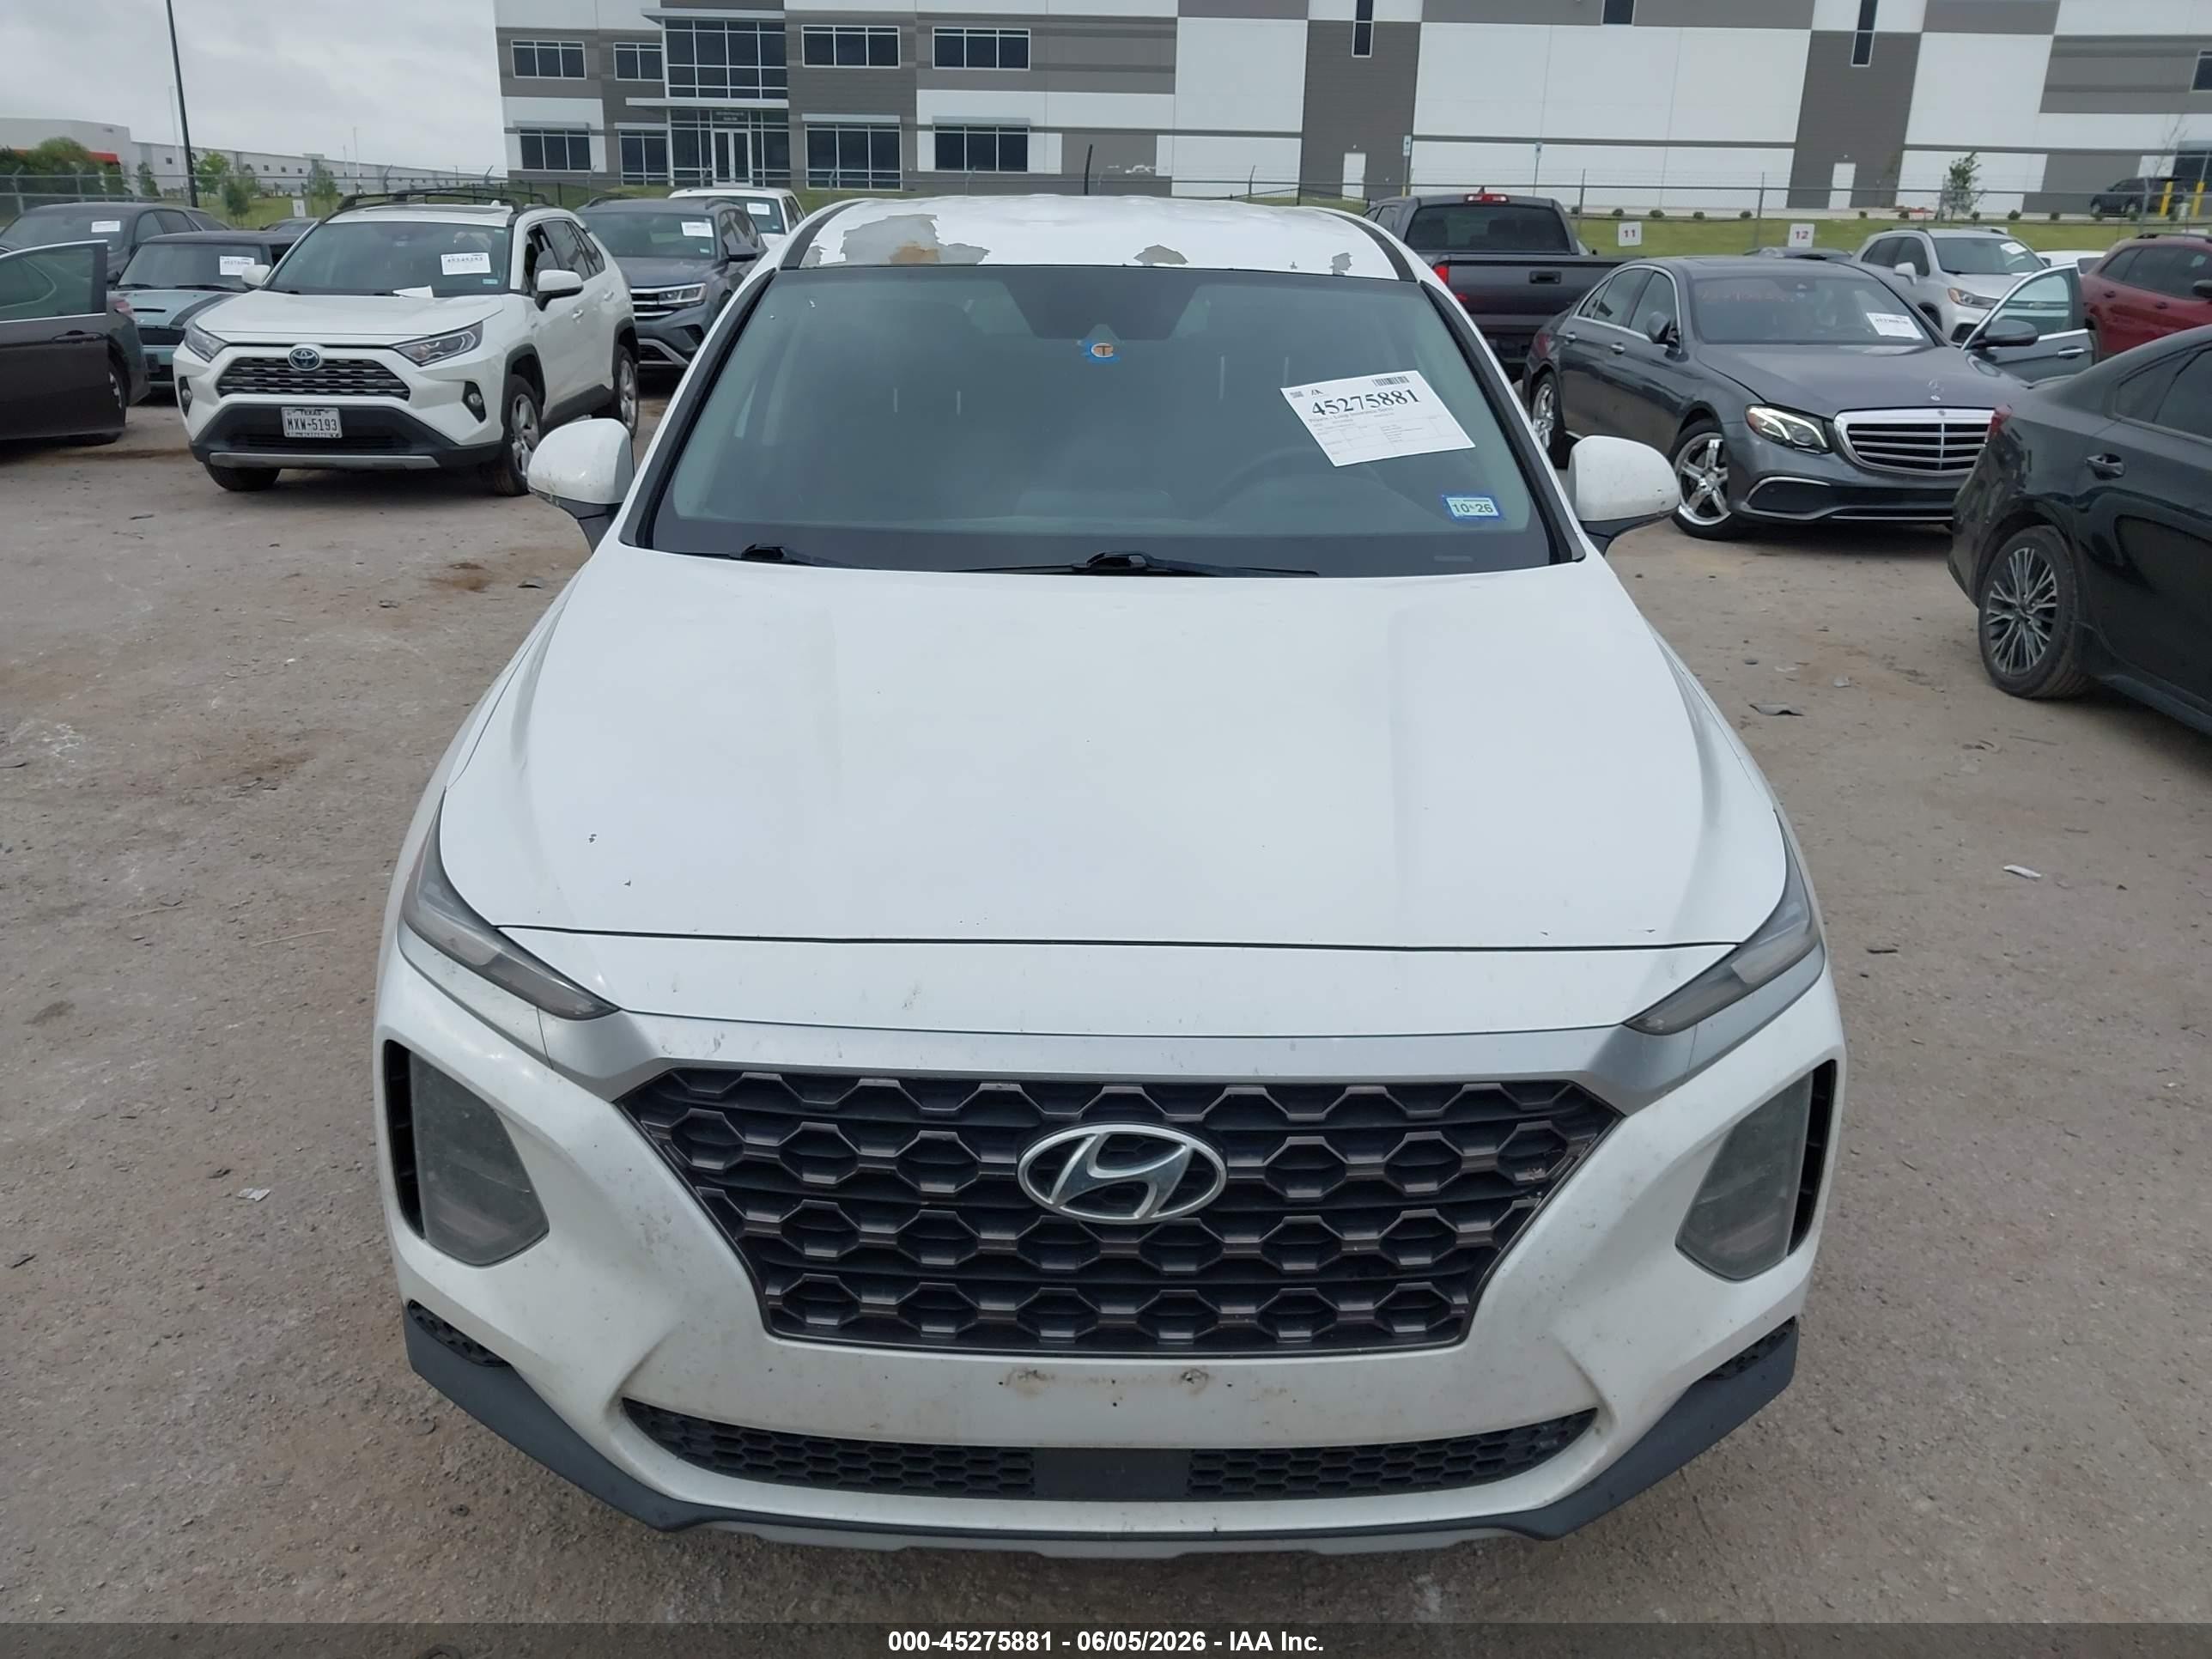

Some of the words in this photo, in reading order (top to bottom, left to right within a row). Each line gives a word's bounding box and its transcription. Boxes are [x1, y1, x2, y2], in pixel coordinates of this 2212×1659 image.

[1624, 229, 1636, 238] 11
[1796, 230, 1808, 240] 12
[1312, 389, 1420, 416] 45275881
